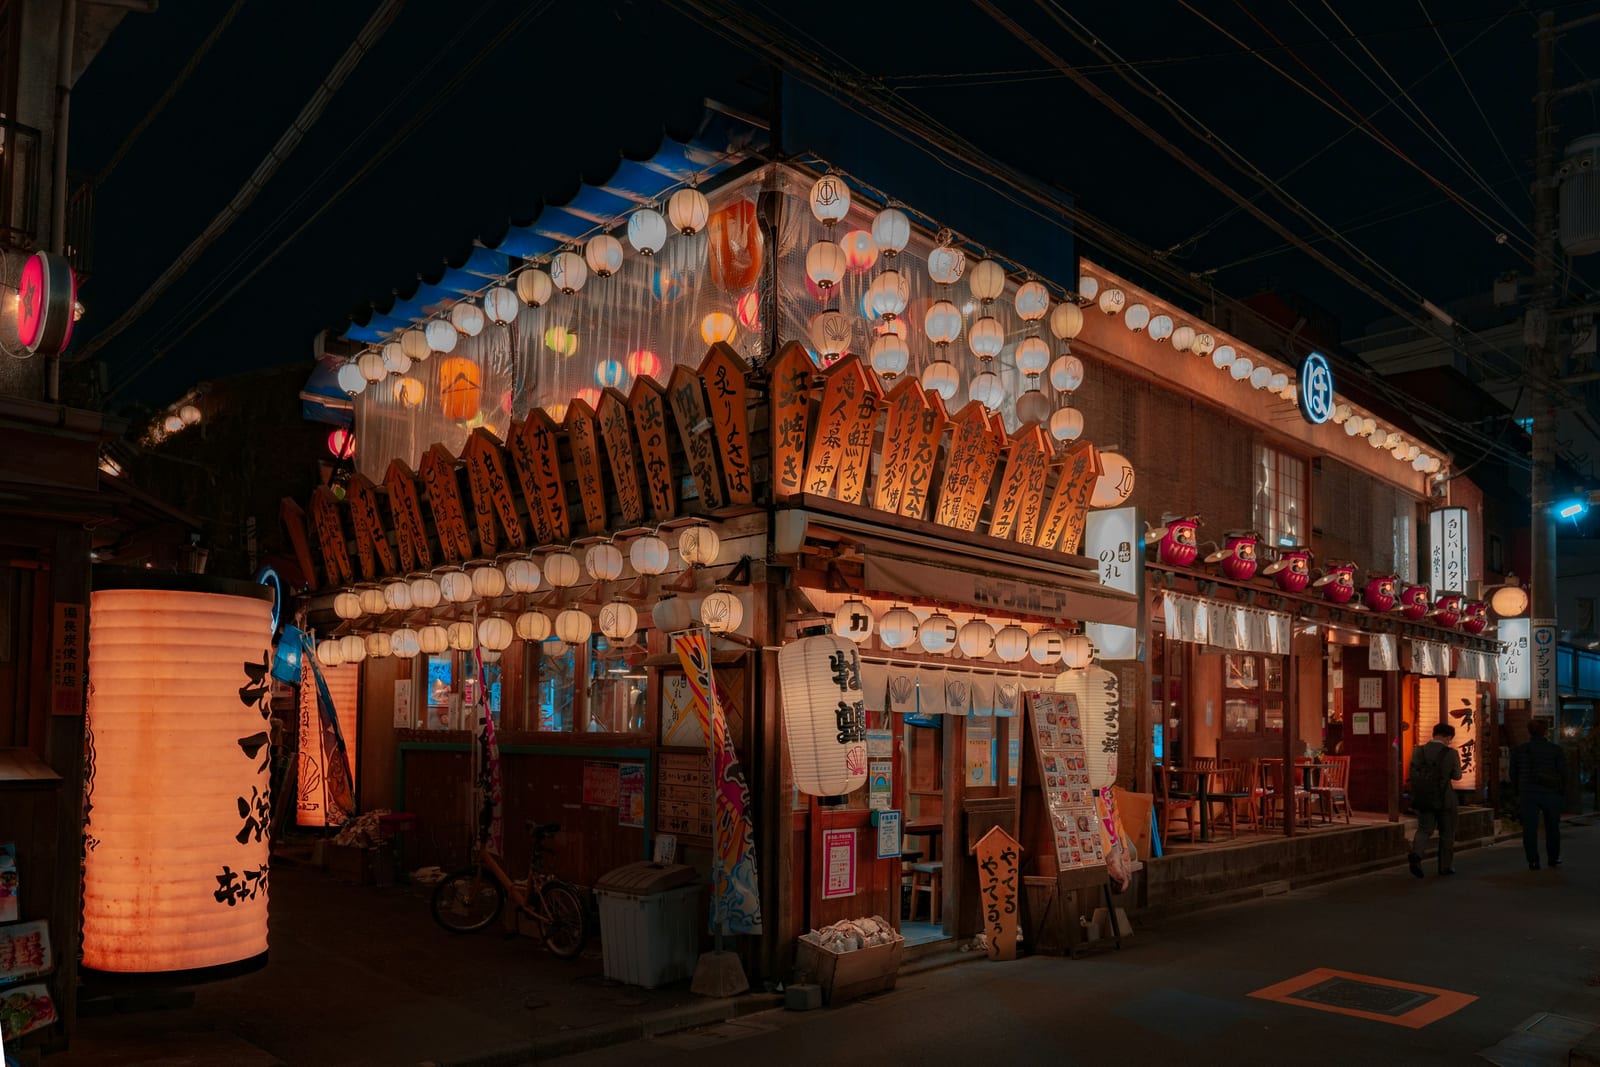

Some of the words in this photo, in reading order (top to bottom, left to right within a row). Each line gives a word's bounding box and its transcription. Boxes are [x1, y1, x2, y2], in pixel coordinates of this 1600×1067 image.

[779, 368, 808, 487] 浜焼き
[1044, 456, 1087, 549] 特大シマホッ
[850, 613, 868, 631] カ
[1000, 847, 1017, 914] やってる
